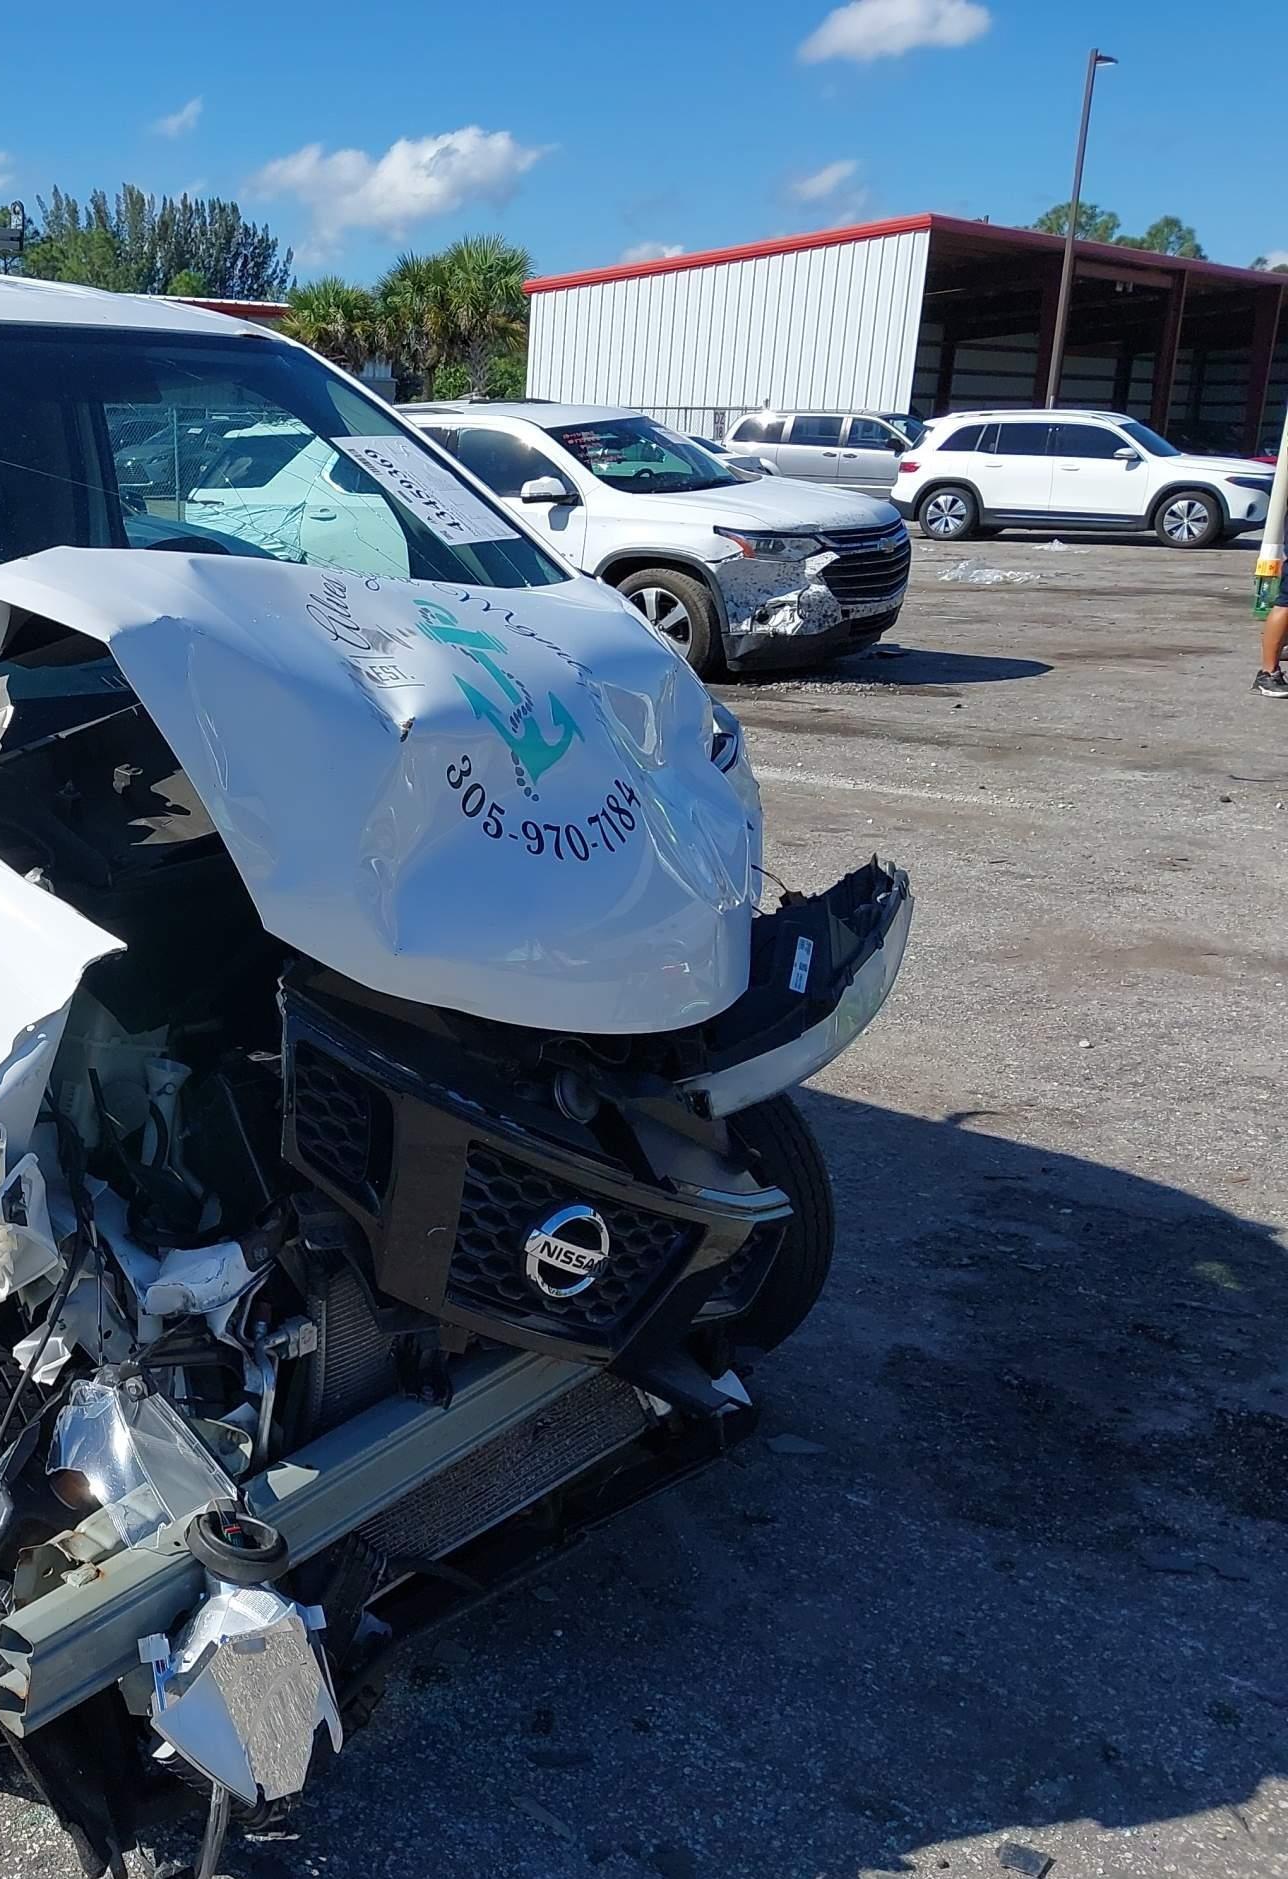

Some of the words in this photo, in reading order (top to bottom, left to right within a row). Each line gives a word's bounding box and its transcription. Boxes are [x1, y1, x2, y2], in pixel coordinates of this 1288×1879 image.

[363, 448, 464, 532] 43459369
[367, 664, 416, 682] EST.
[447, 754, 641, 862] 305-970-7184
